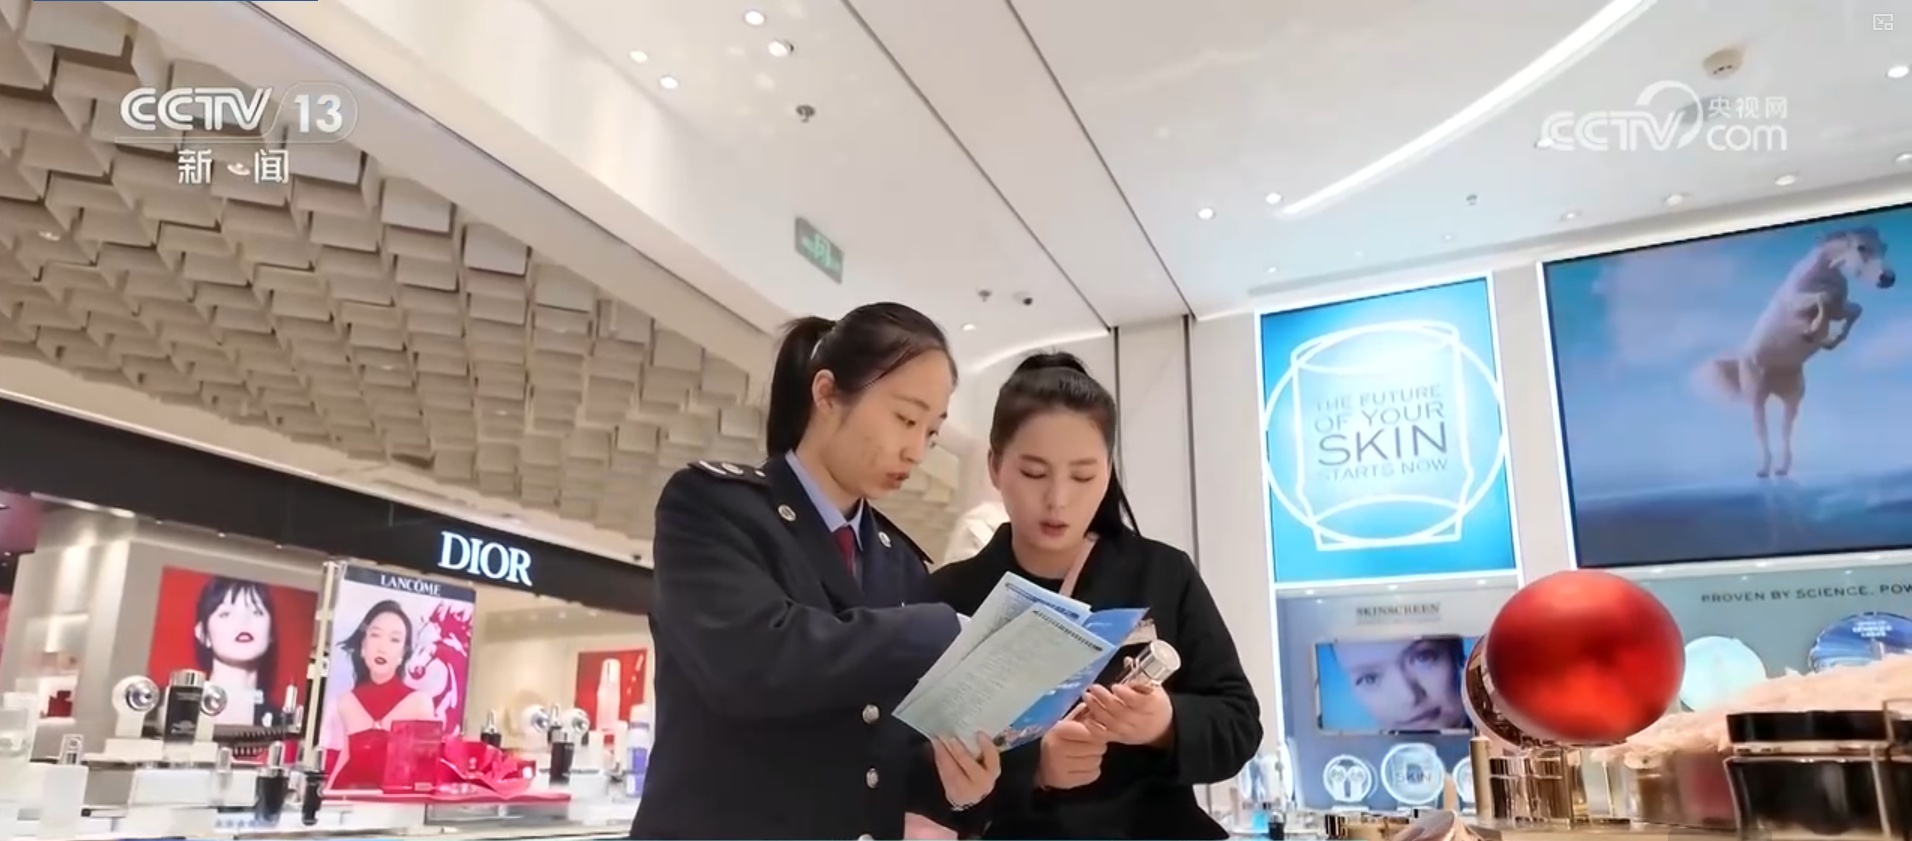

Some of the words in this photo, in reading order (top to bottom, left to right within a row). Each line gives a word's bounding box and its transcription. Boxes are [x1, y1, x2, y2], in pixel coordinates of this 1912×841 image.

[1315, 396, 1352, 413] THE
[1360, 384, 1443, 407] FUTURE
[1314, 413, 1350, 434] OF
[1361, 400, 1445, 427] YOUR
[1318, 421, 1447, 466] SKIN
[1323, 463, 1395, 482] STARTS
[1401, 459, 1448, 474] NOW
[438, 531, 533, 587] DIOR
[1701, 591, 1766, 603] PROVEN
[1771, 589, 1791, 600] BY
